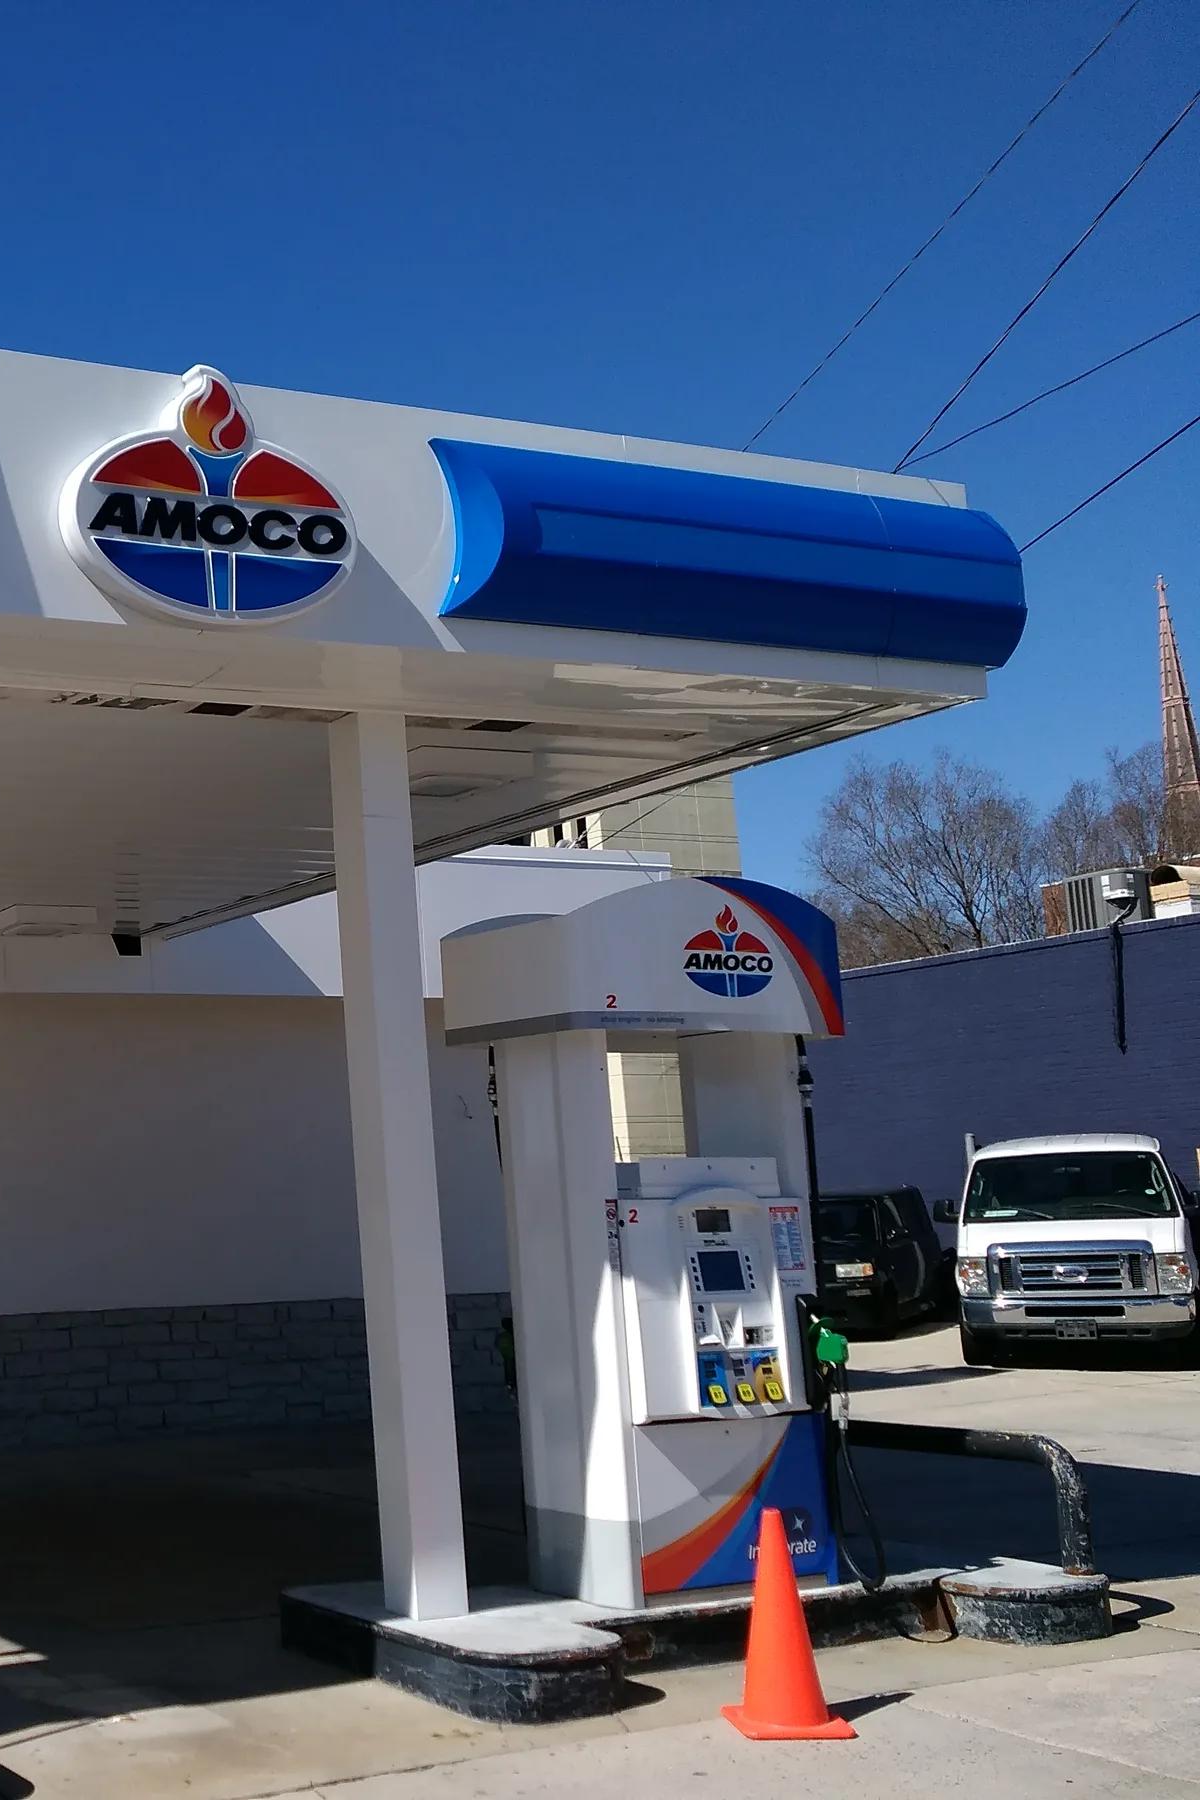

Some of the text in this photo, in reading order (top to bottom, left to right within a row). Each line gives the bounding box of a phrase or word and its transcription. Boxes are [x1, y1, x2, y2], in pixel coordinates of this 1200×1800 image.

[87, 492, 348, 555] AMOCO
[683, 952, 774, 973] AMOCO
[606, 994, 618, 1009] 2
[628, 1208, 639, 1224] 2
